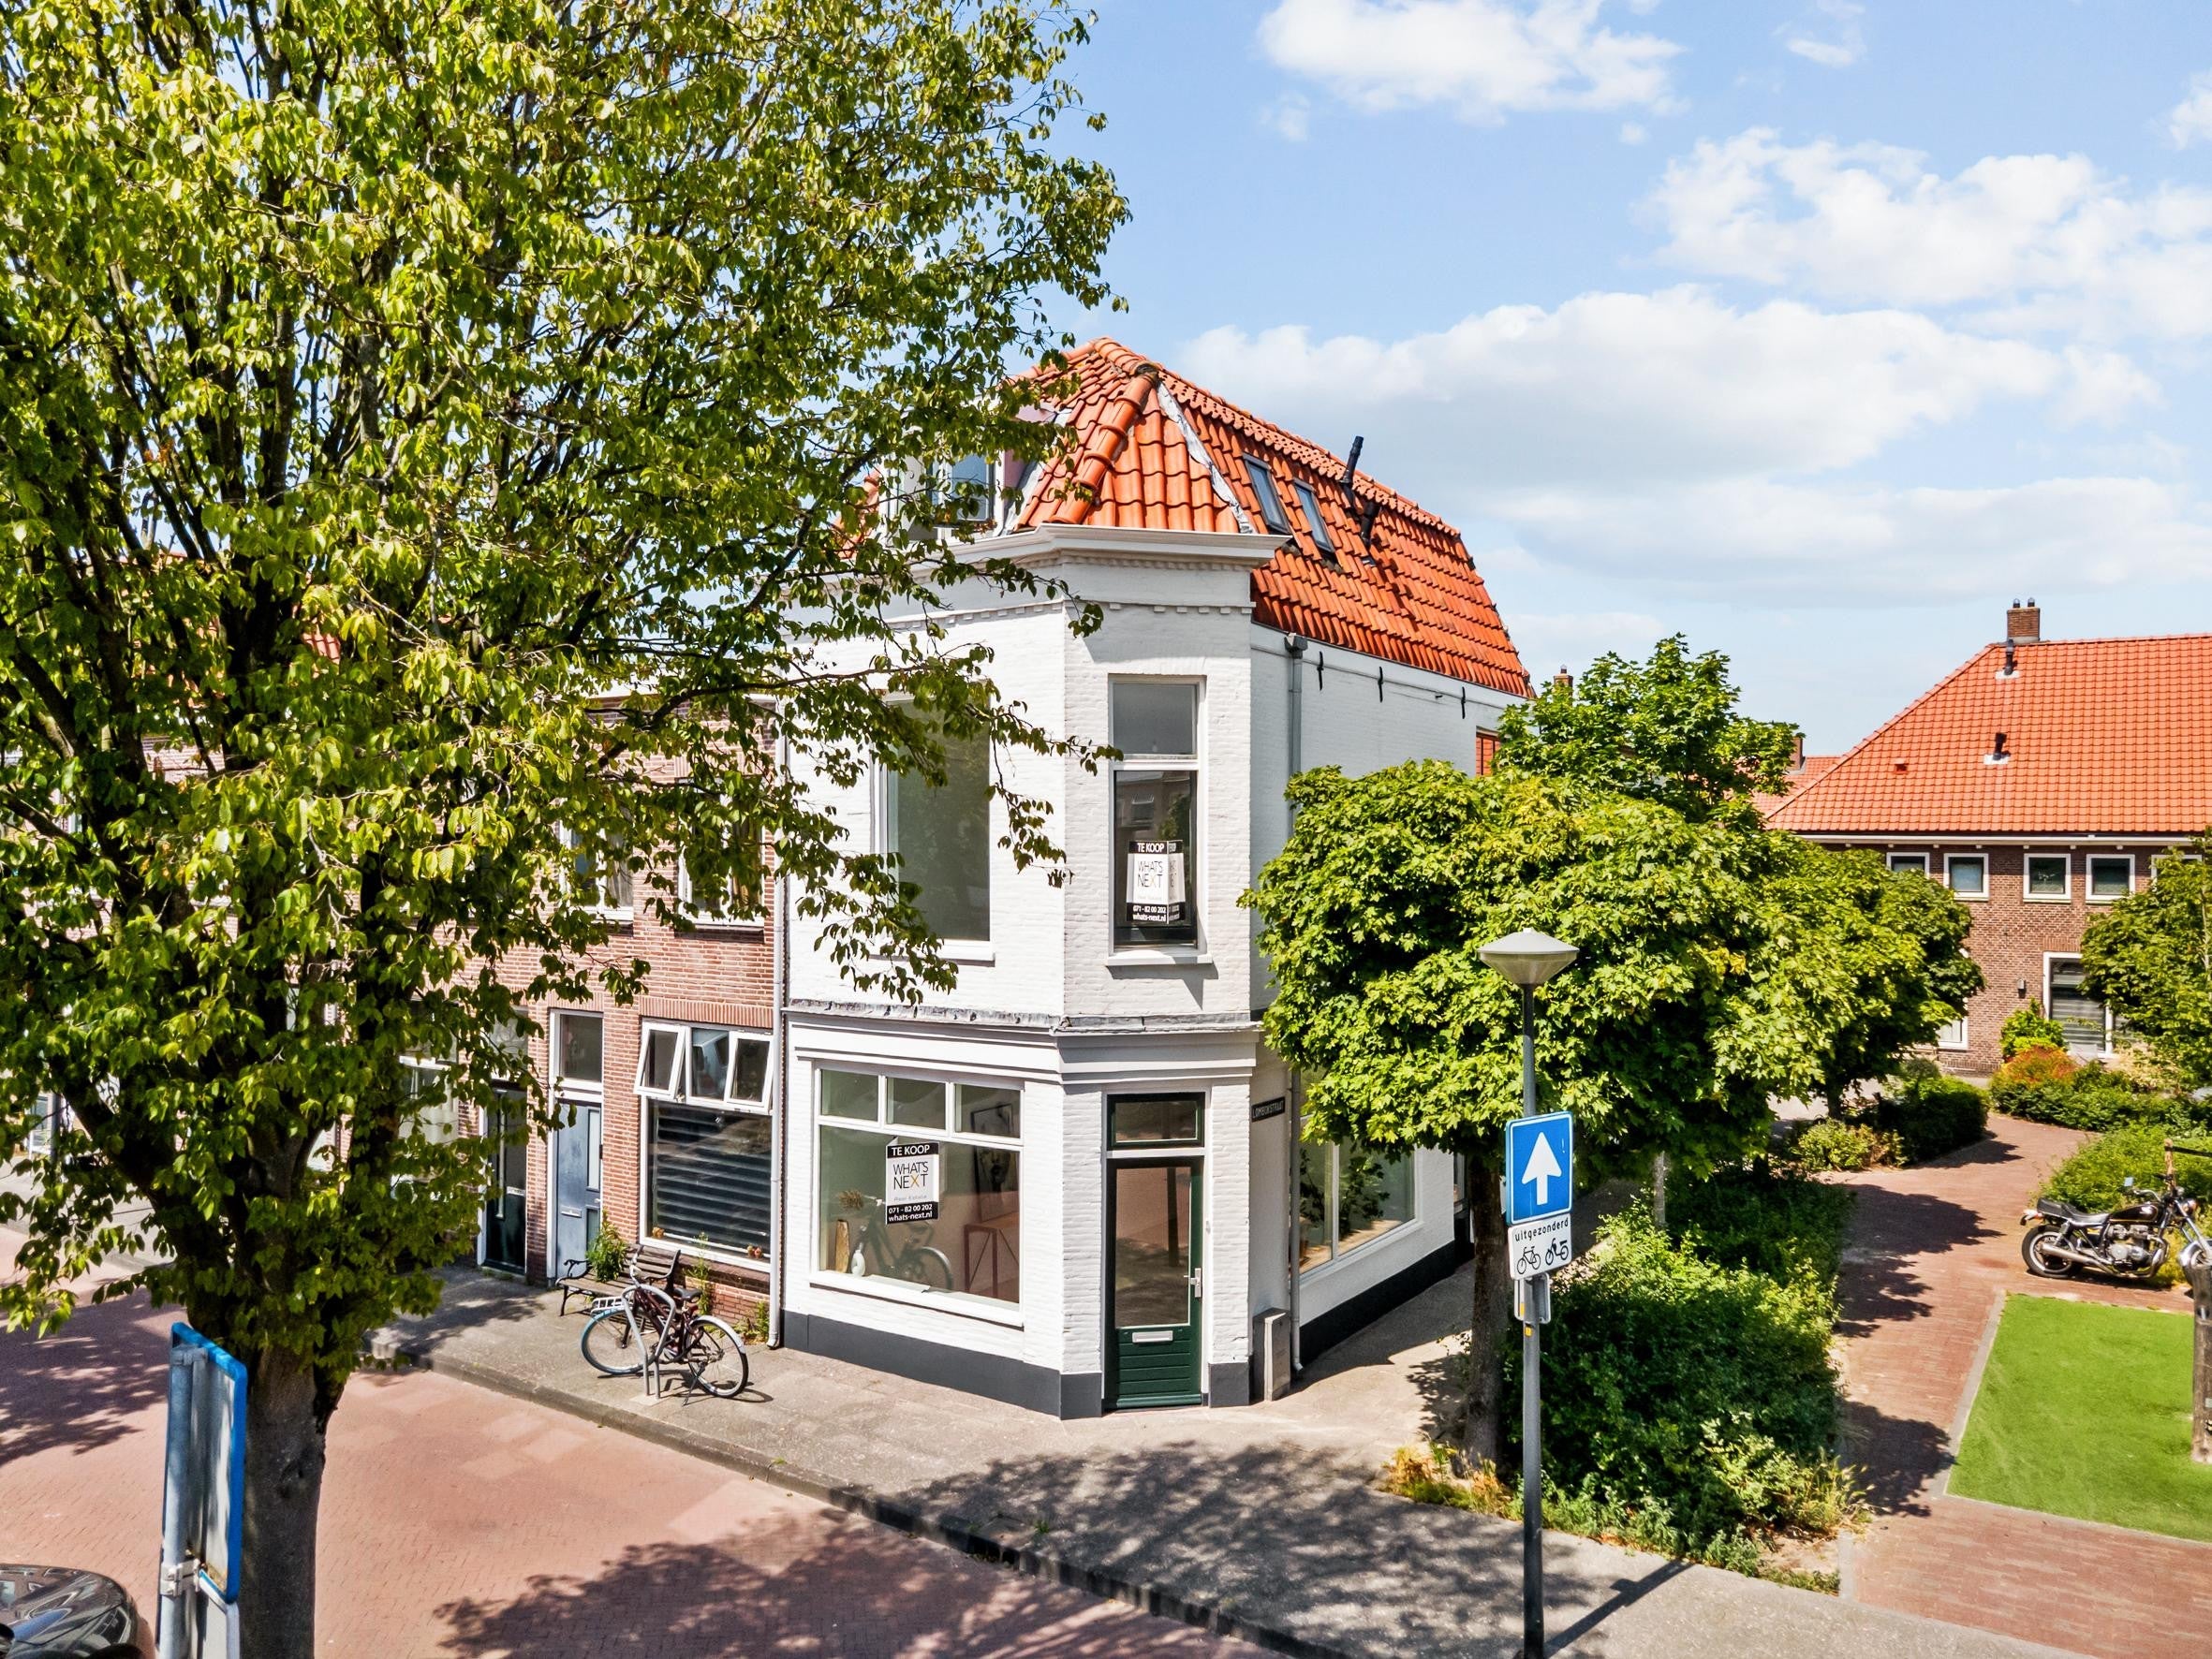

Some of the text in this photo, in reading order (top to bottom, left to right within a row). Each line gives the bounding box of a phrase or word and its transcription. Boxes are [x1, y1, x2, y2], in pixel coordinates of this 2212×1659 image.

[1137, 843, 1145, 852] TE
[1145, 843, 1164, 852] KOOP
[1138, 874, 1162, 888] NEXT
[892, 1144, 930, 1156] TE KOOP
[893, 1173, 929, 1190] NEXT
[888, 1211, 933, 1222] whats-next.nl
[1514, 1217, 1569, 1241] uitgezonderd
